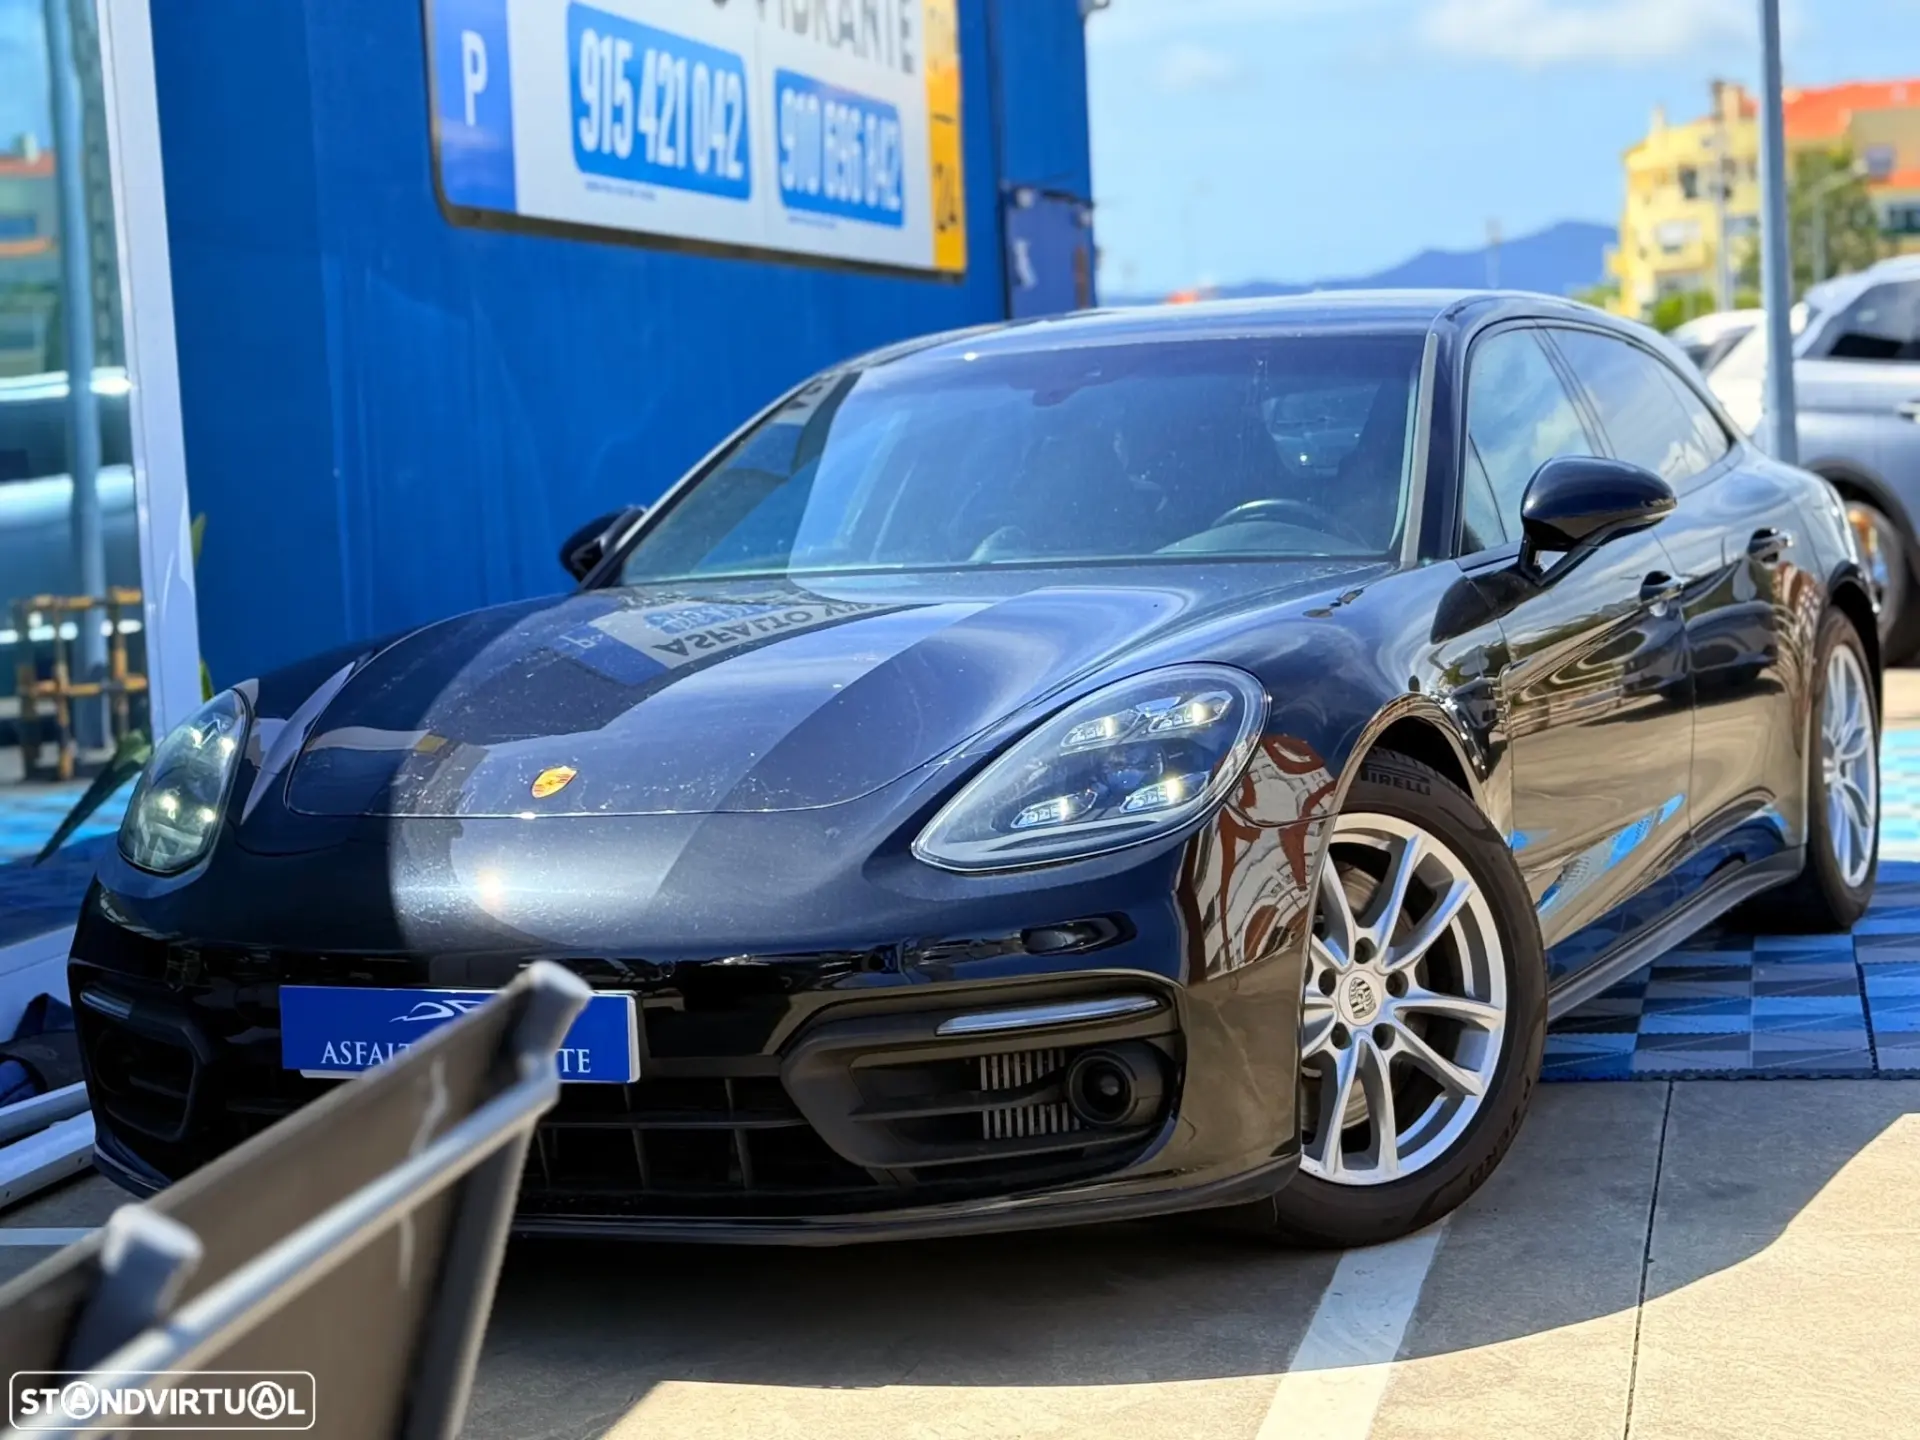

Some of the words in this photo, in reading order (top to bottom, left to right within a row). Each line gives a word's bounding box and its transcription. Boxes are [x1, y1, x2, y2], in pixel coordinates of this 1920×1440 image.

[461, 29, 488, 127] P
[579, 27, 634, 160] 915
[637, 47, 688, 171] 421
[691, 60, 744, 181] 042
[1360, 762, 1432, 796] PIRELLI
